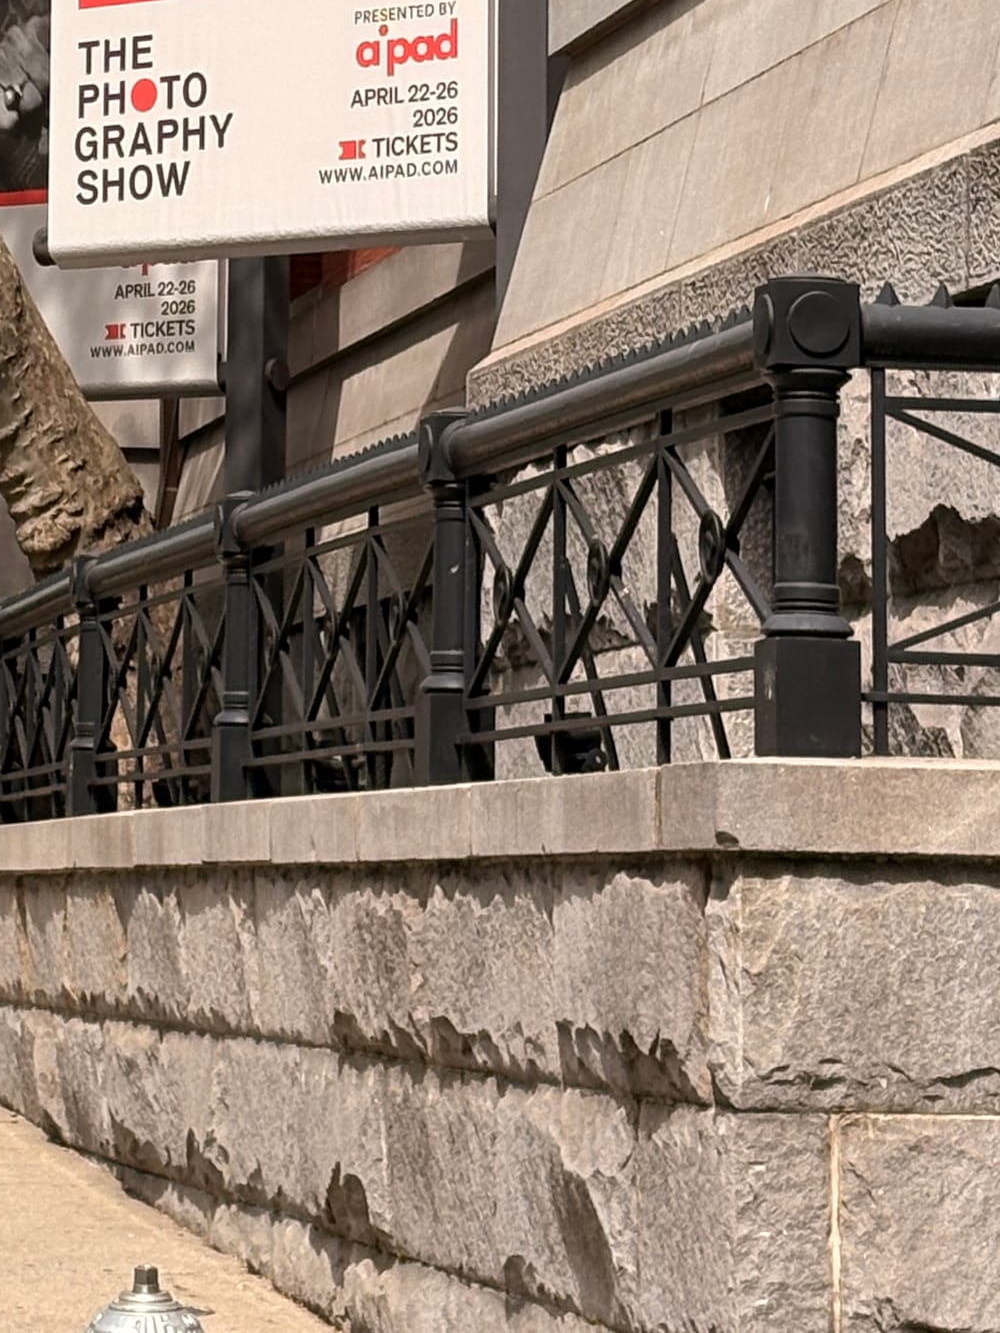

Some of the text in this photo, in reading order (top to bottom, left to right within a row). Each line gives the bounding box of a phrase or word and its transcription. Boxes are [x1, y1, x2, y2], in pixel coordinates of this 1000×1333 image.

[354, 1, 456, 25] PRESENTED BY
[78, 34, 153, 75] THE
[355, 17, 458, 77] aipad
[78, 71, 207, 119] PHOTO
[350, 81, 458, 108] APRIL 22-26
[413, 106, 458, 128] 2026
[74, 112, 234, 162] GRAPHY
[372, 132, 458, 158] TICKETS
[76, 160, 191, 206] SHOW
[318, 159, 458, 185] WWW.AIPAD.COM
[114, 280, 196, 300] APRIL 22-26
[161, 300, 196, 316] 2026
[130, 320, 195, 339] TICKETS
[90, 340, 195, 358] WWW.AIPAD.COM
